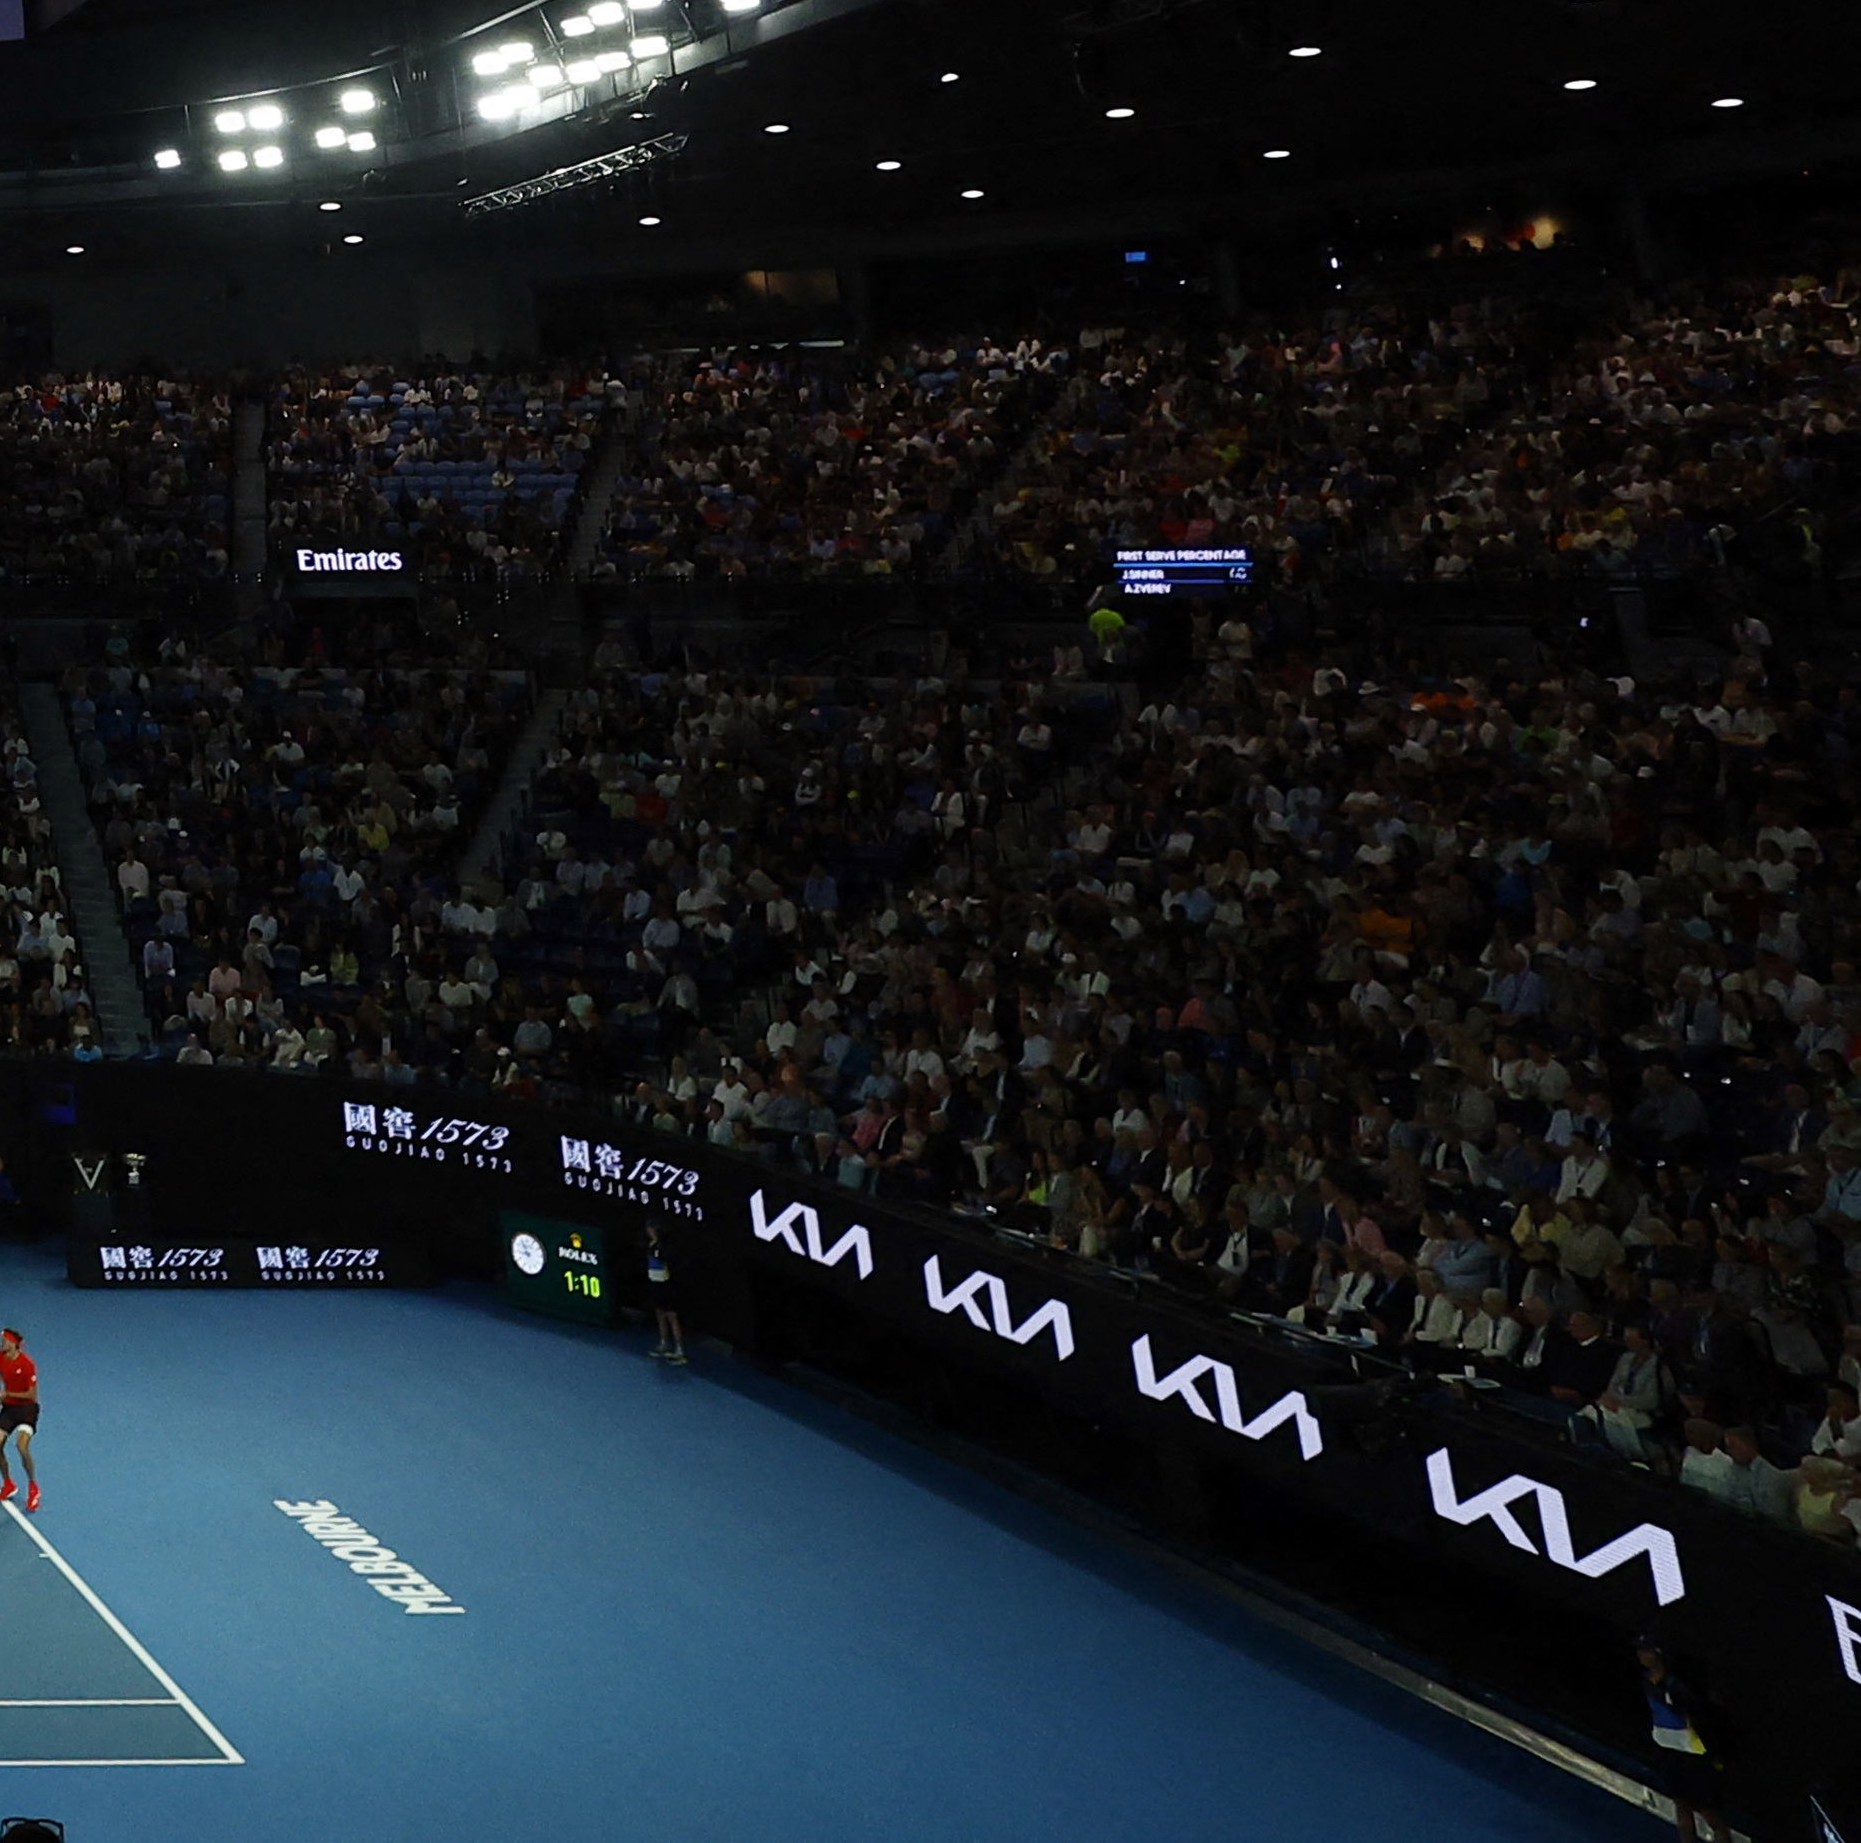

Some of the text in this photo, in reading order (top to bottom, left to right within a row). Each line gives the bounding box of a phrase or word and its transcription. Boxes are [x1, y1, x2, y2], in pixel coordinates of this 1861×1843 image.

[297, 548, 402, 571] Emirates
[1116, 550, 1144, 562] FIRST
[1145, 550, 1176, 562] SERVE
[420, 1117, 509, 1151] 1573
[346, 1135, 446, 1161] GUOJIAO
[564, 1171, 650, 1205] GUOJIAO
[627, 1158, 699, 1197] 1573
[158, 1248, 224, 1267] 1573
[314, 1248, 379, 1267] 1573
[558, 1246, 598, 1266] ROLEX
[564, 1270, 600, 1298] 1:10
[272, 1499, 467, 1615] MELBOURNE
